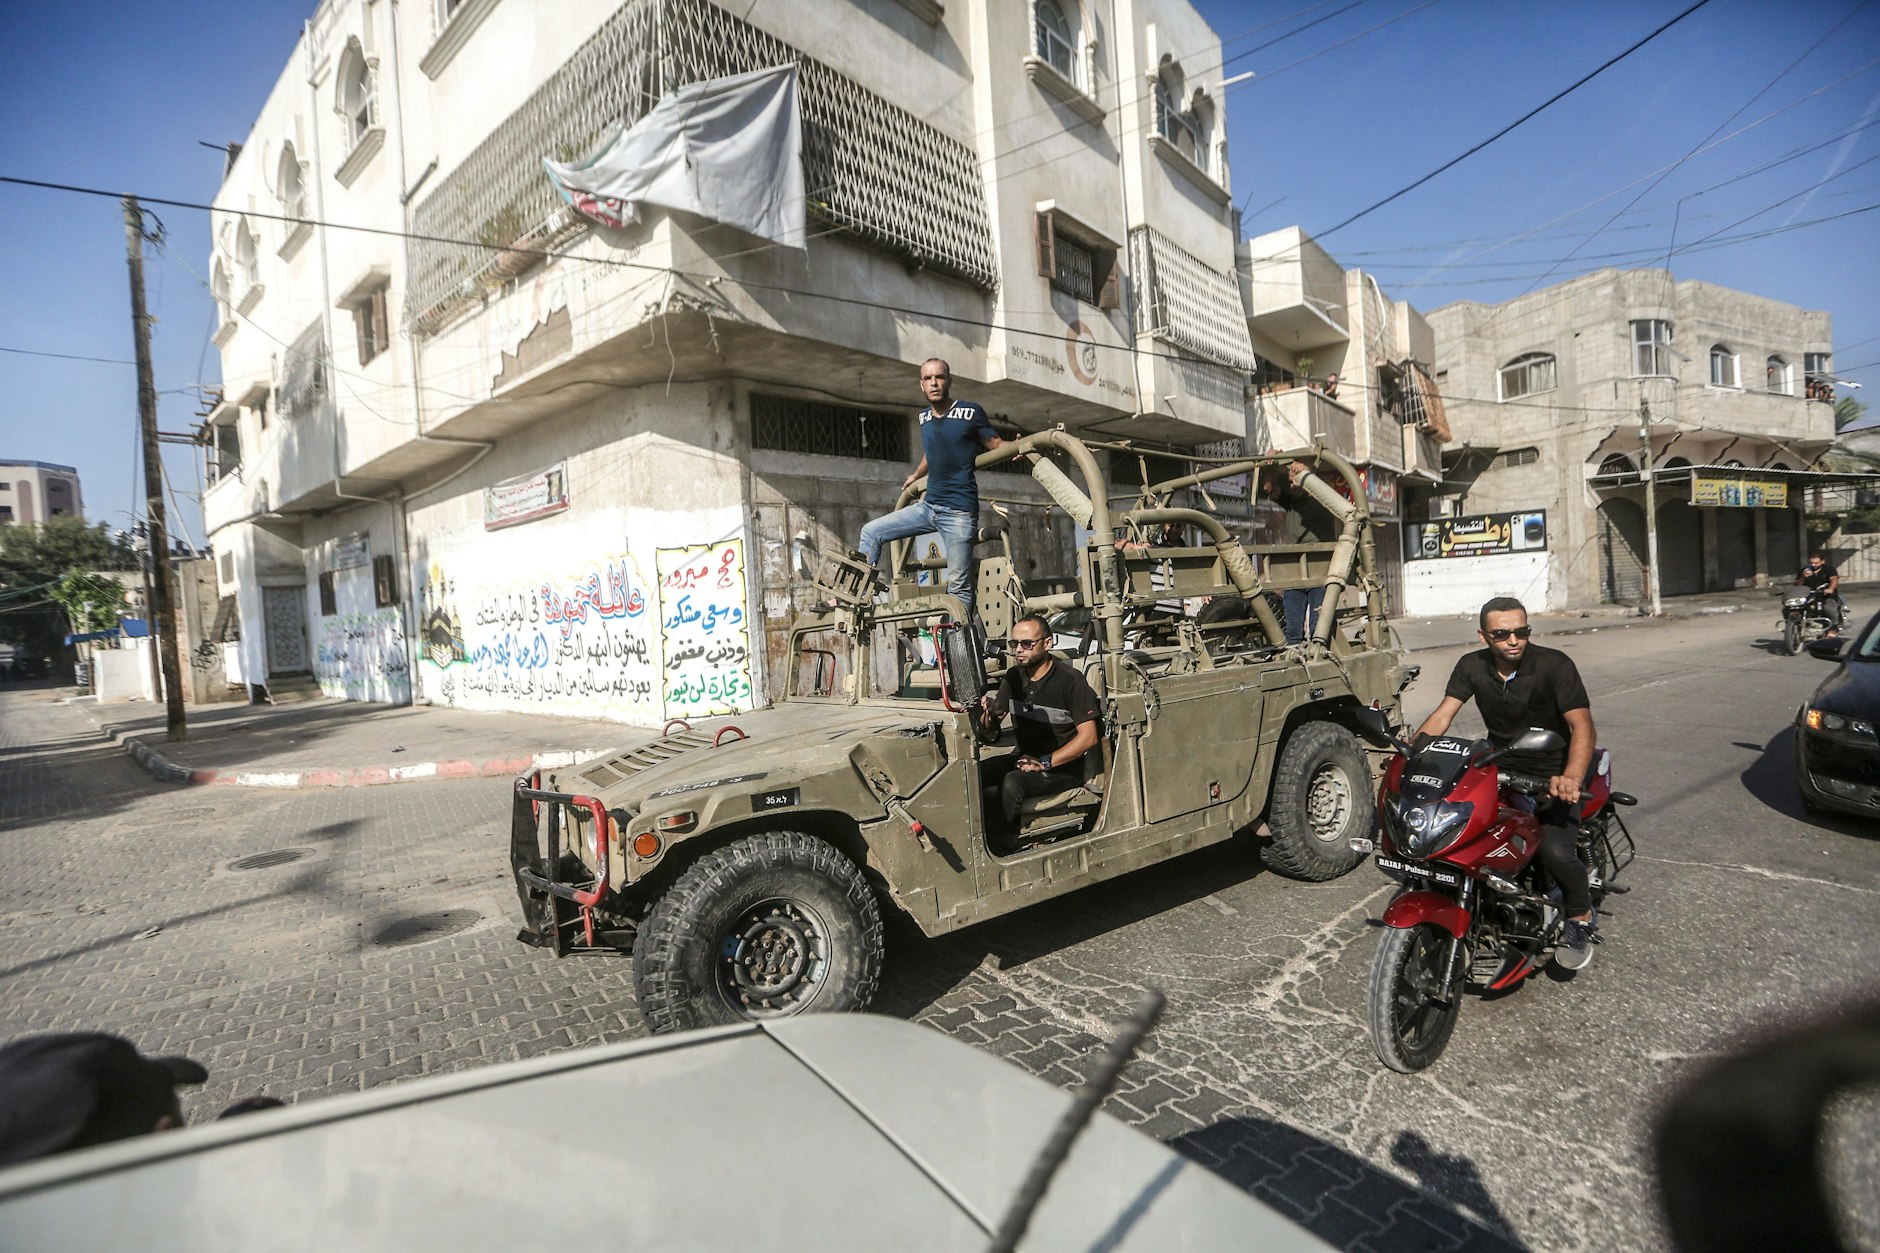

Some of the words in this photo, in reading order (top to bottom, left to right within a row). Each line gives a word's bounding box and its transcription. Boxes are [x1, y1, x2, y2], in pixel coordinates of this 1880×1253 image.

[1441, 516, 1511, 551] وطن
[663, 566, 709, 589] مبرور
[717, 549, 735, 589] حج
[664, 595, 701, 629] مشكور
[665, 639, 705, 669] مغفور
[706, 638, 746, 669] وذنب
[665, 673, 688, 704] تبور
[689, 674, 706, 703] لن
[709, 670, 750, 703] وتجارة
[1379, 858, 1402, 870] BAJAJ
[1404, 864, 1429, 877] Pulsar
